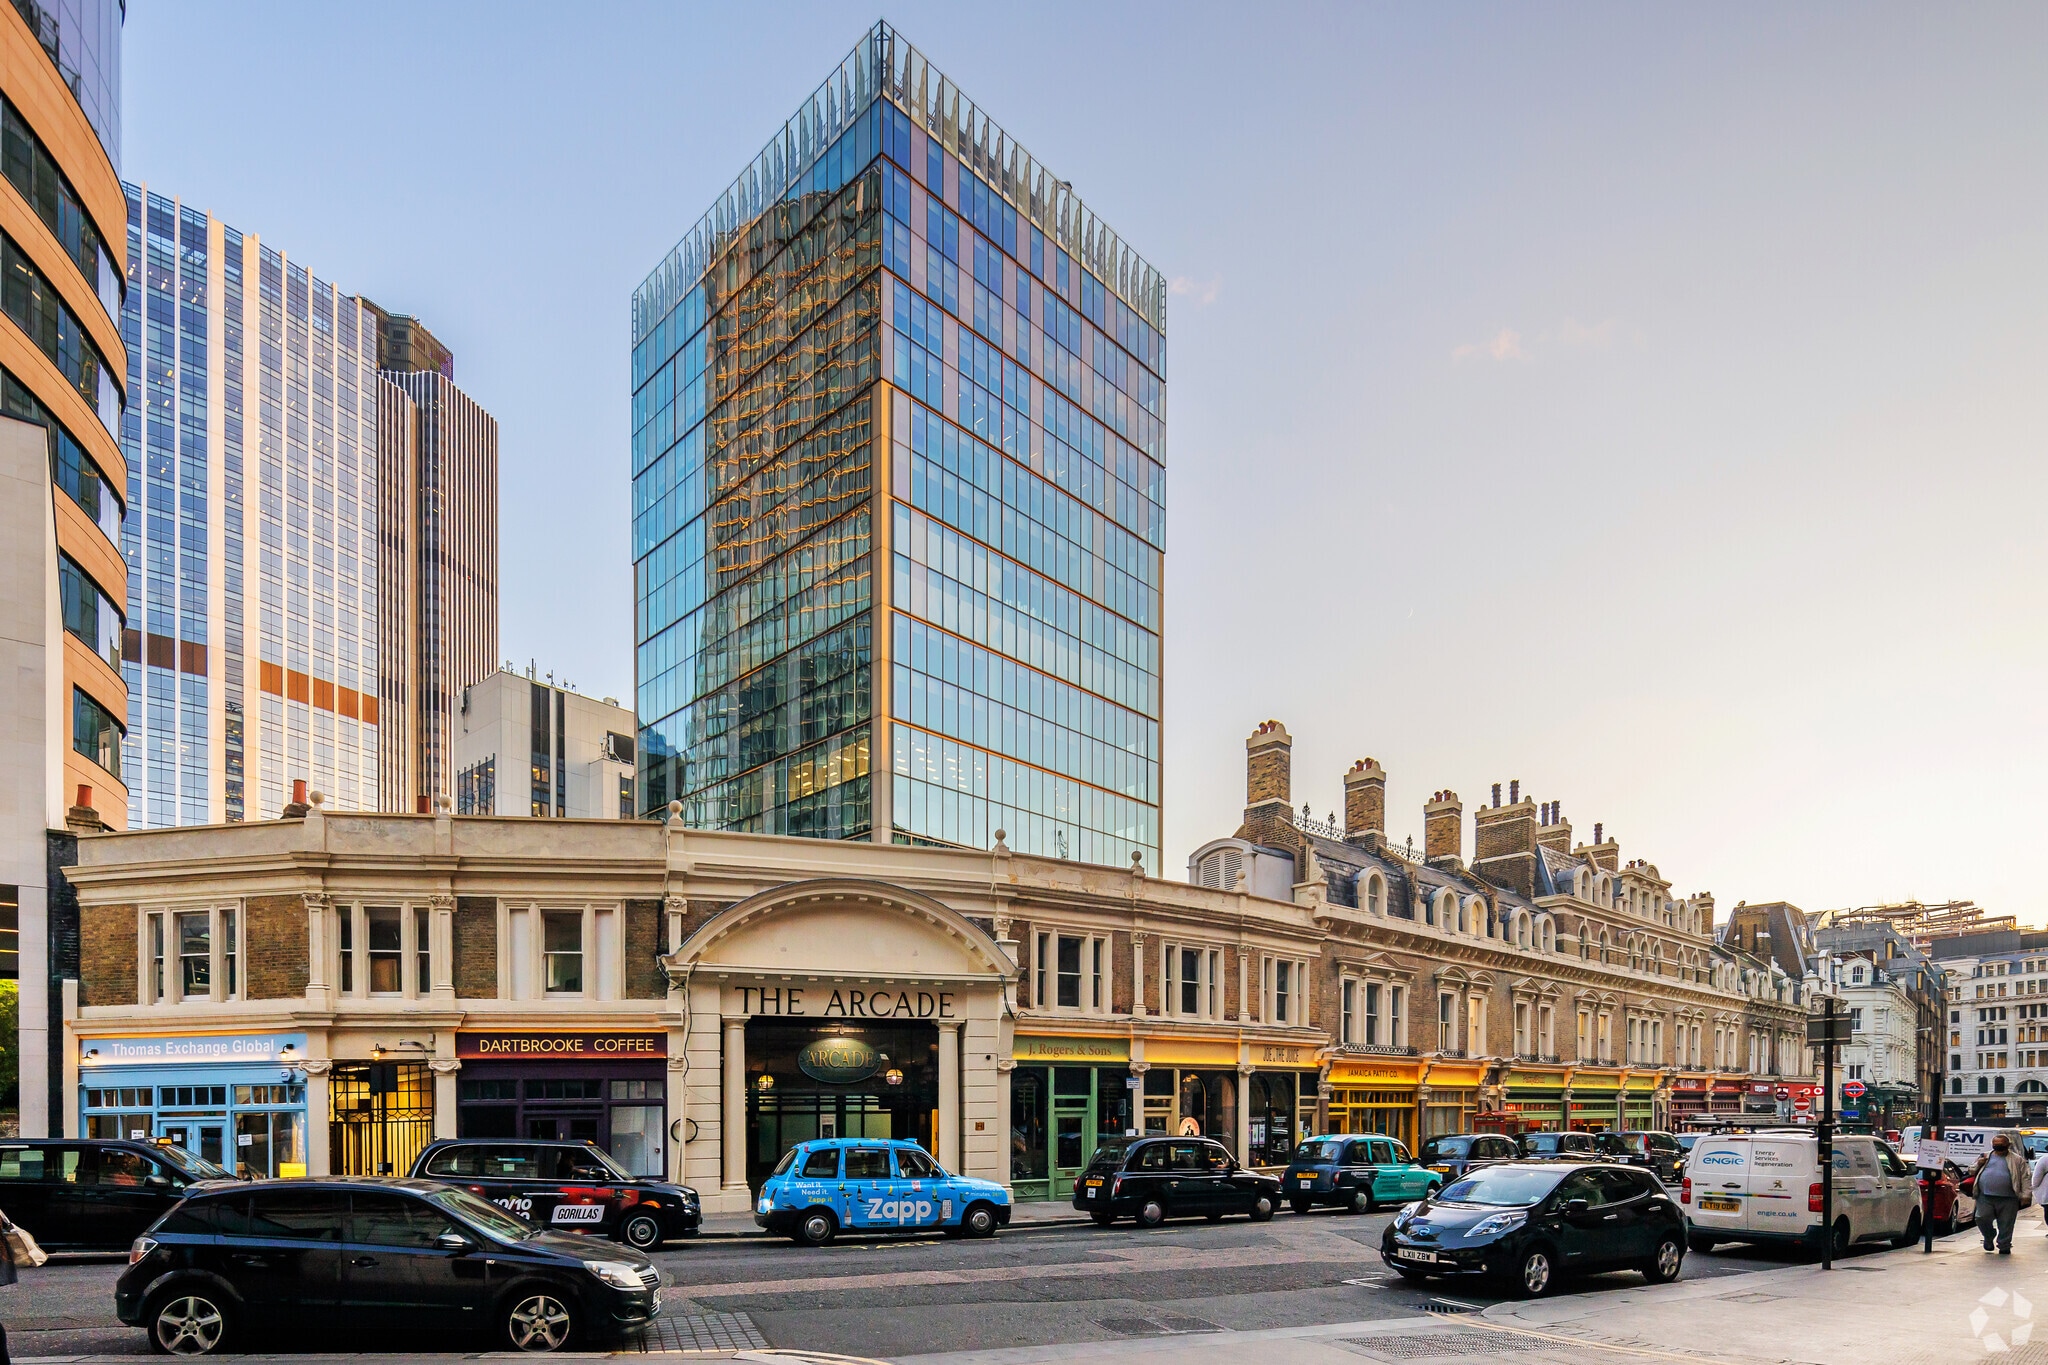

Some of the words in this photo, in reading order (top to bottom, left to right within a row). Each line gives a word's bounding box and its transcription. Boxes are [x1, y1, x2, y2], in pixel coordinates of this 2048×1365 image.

[734, 986, 805, 1015] THE
[823, 989, 955, 1019] ARCADE
[112, 1043, 161, 1057] Thomas
[165, 1041, 228, 1057] Exchange
[232, 1039, 274, 1053] Global
[479, 1039, 584, 1053] DARTBROOKE
[593, 1039, 655, 1052] COFFEE
[1028, 1044, 1036, 1056] J.
[1039, 1044, 1075, 1058] Rogers
[1077, 1045, 1086, 1055] &
[1088, 1046, 1112, 1056] Sons
[806, 1050, 875, 1068] ARCADE
[1348, 1069, 1371, 1077] JAMAICA
[1373, 1070, 1388, 1078] PATTY
[557, 1208, 600, 1220] GORILLAS
[867, 1198, 932, 1226] Zapp
